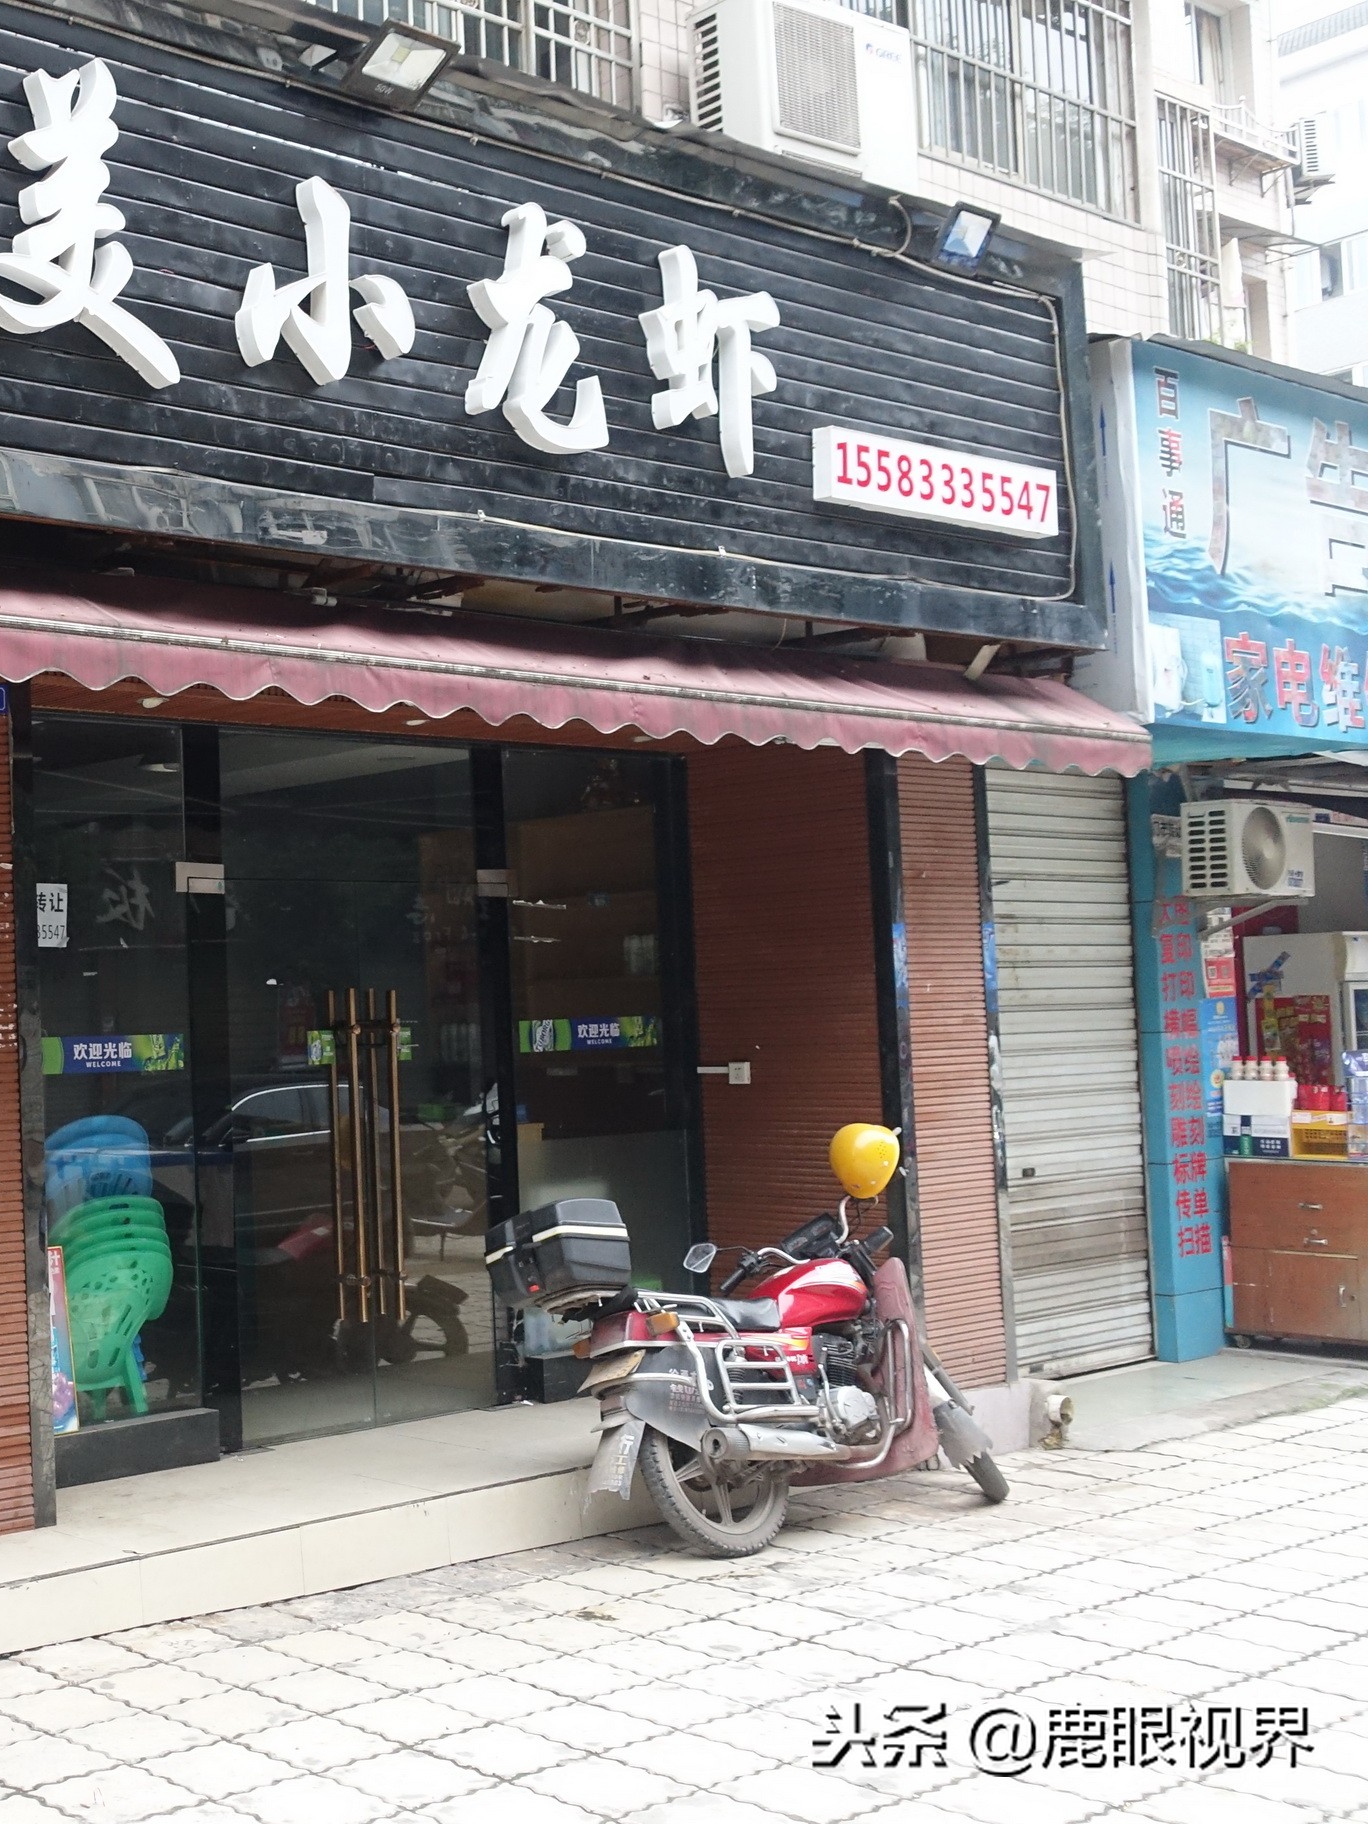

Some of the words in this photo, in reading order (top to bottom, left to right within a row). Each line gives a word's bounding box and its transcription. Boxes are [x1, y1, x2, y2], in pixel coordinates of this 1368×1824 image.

[1153, 365, 1187, 540] 百事通
[836, 441, 1052, 523] 15583335547
[1223, 631, 1368, 734] 家电维
[577, 1022, 621, 1039] 欢迎光临
[73, 1041, 132, 1061] 欢迎光临
[586, 1038, 613, 1046] WELCOME
[85, 1060, 122, 1069] WELCOME
